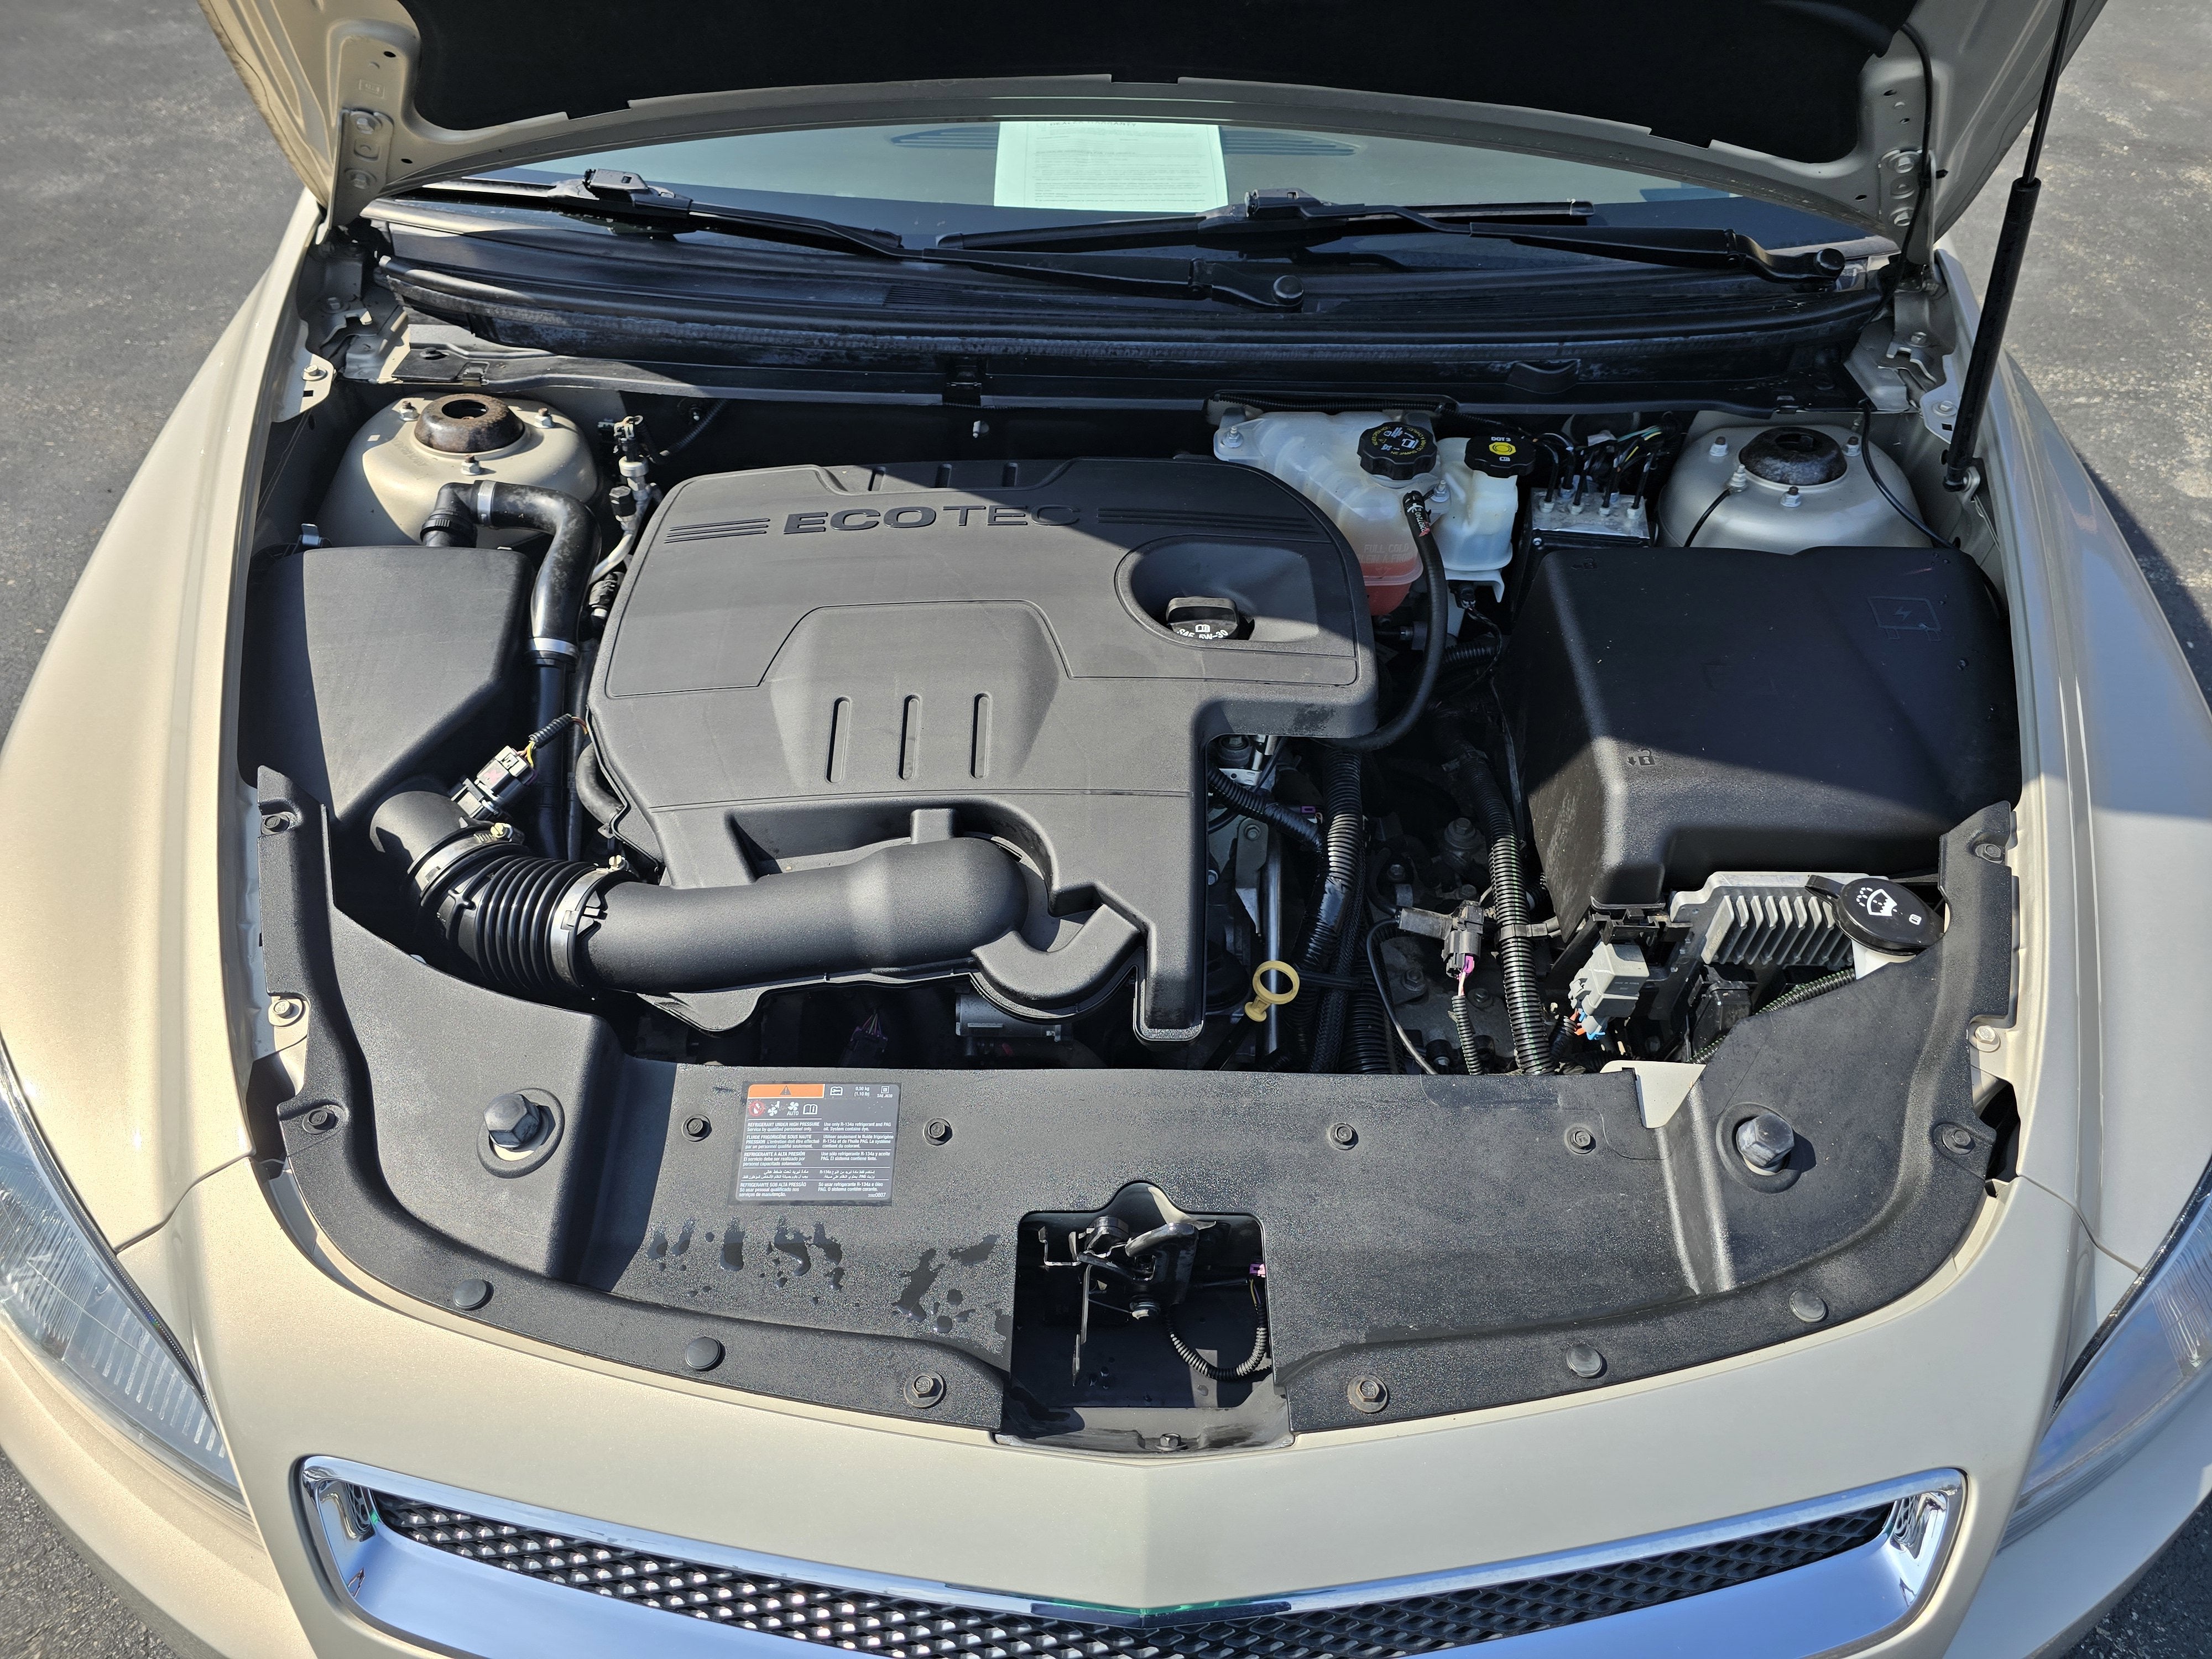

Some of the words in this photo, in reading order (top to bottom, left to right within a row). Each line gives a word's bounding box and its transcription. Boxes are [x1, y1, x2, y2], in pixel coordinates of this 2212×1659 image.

[783, 505, 1081, 535] ECOTEC
[1364, 544, 1385, 552] FULL
[1389, 544, 1410, 552] COLD
[1177, 628, 1195, 638] SAE
[1199, 630, 1228, 640] 5W-30
